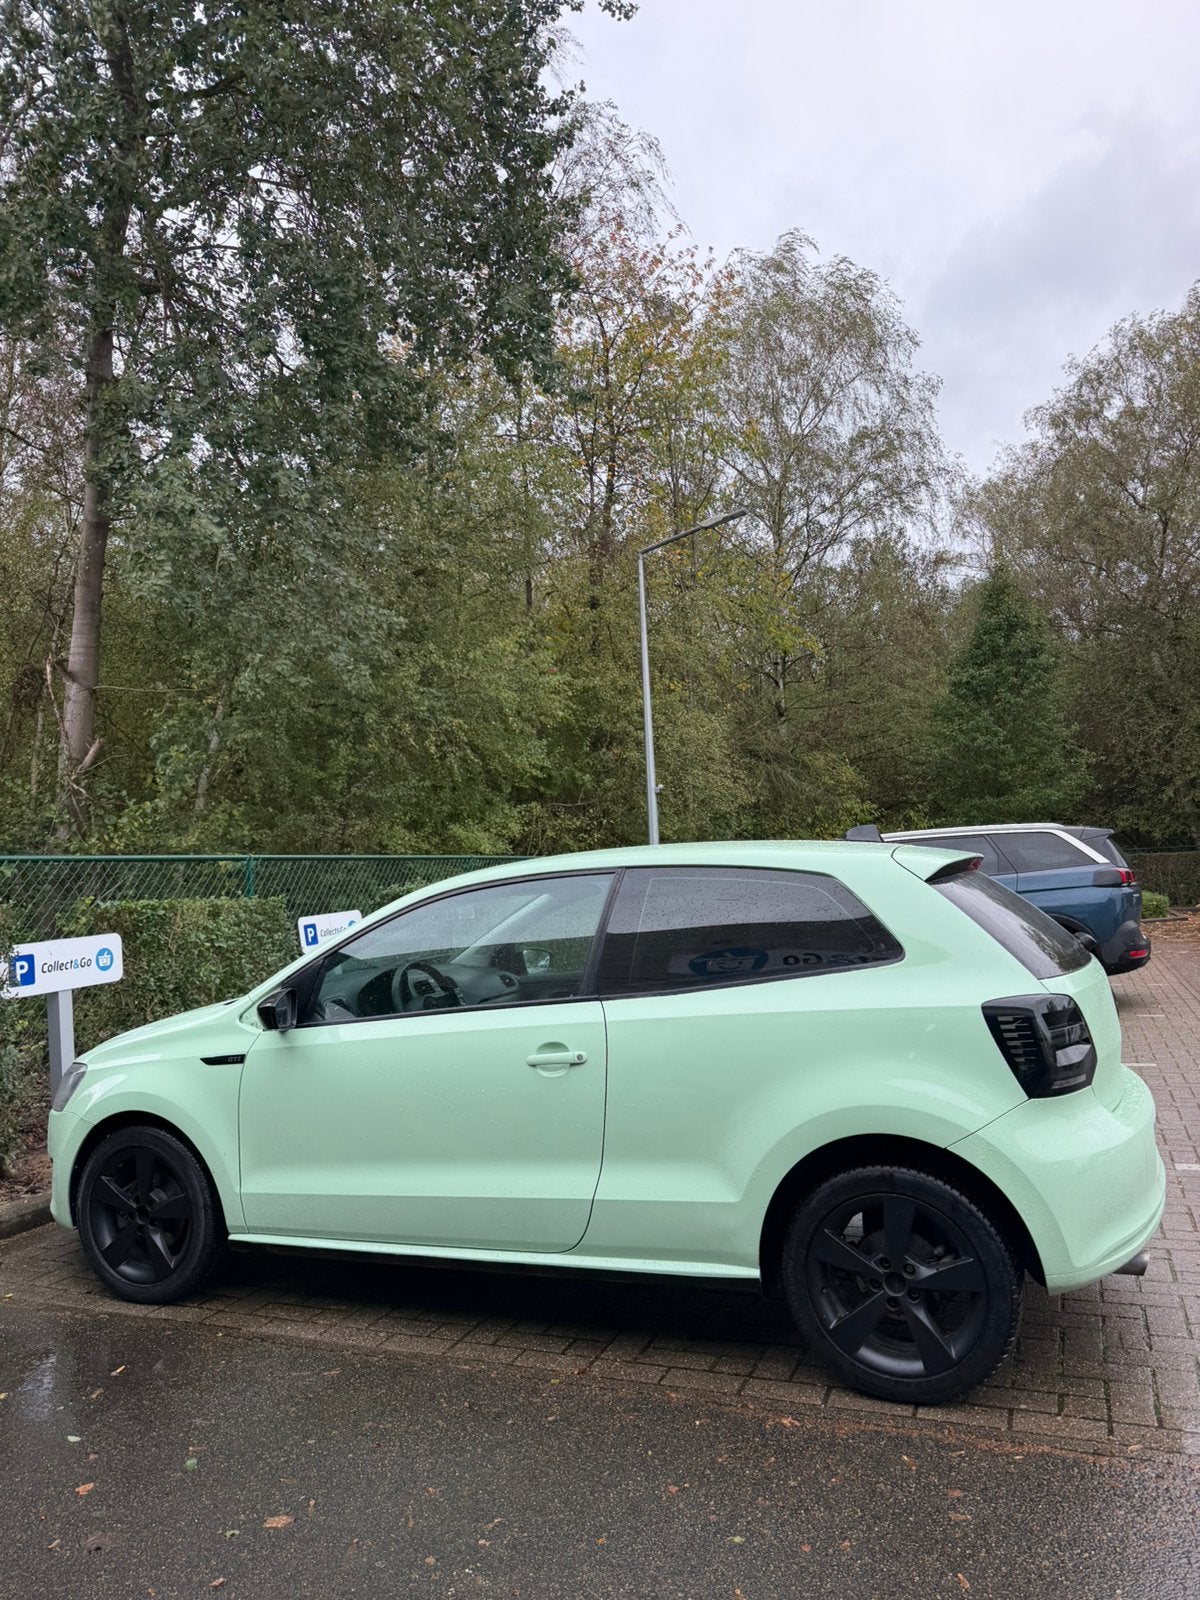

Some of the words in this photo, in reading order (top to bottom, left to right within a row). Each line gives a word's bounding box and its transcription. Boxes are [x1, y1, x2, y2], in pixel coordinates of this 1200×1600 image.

[306, 927, 315, 943] P
[15, 960, 29, 982] P
[41, 957, 92, 974] Collect&Go
